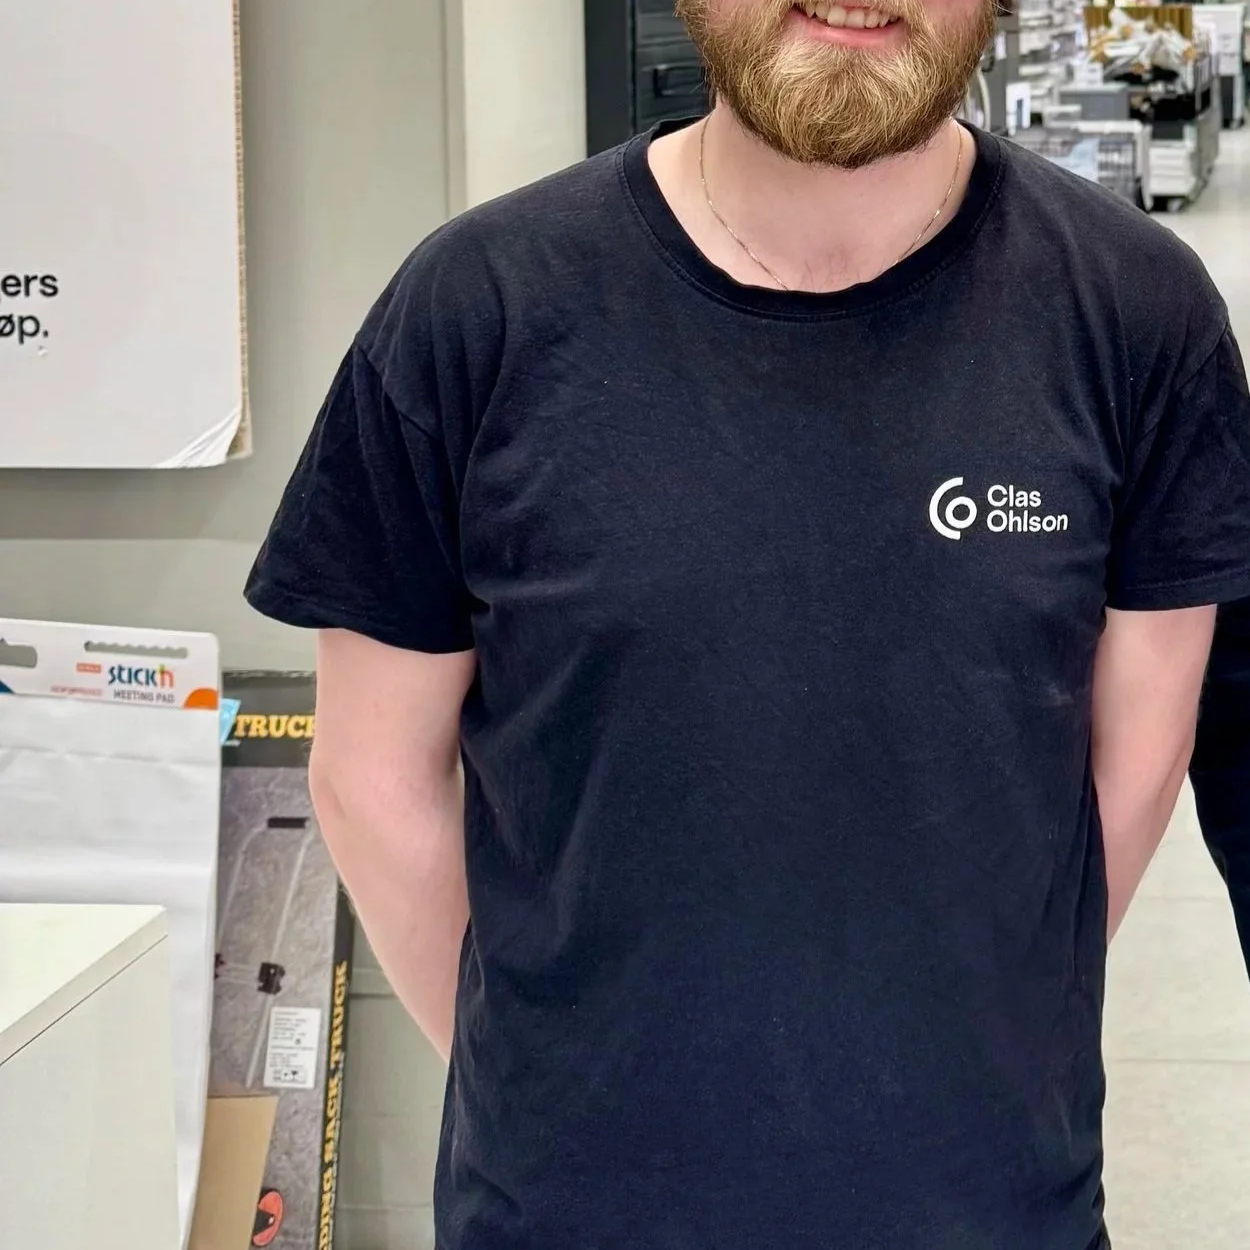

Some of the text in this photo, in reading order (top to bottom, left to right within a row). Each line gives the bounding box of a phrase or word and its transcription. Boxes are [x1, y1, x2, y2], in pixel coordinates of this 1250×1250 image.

[0, 274, 58, 298] ers
[987, 484, 1042, 508] Clas
[986, 509, 1069, 533] Ohlson
[113, 689, 154, 702] MEETING
[156, 693, 176, 704] PAD
[319, 1167, 333, 1250] DING
[330, 959, 347, 1069] TRUCK
